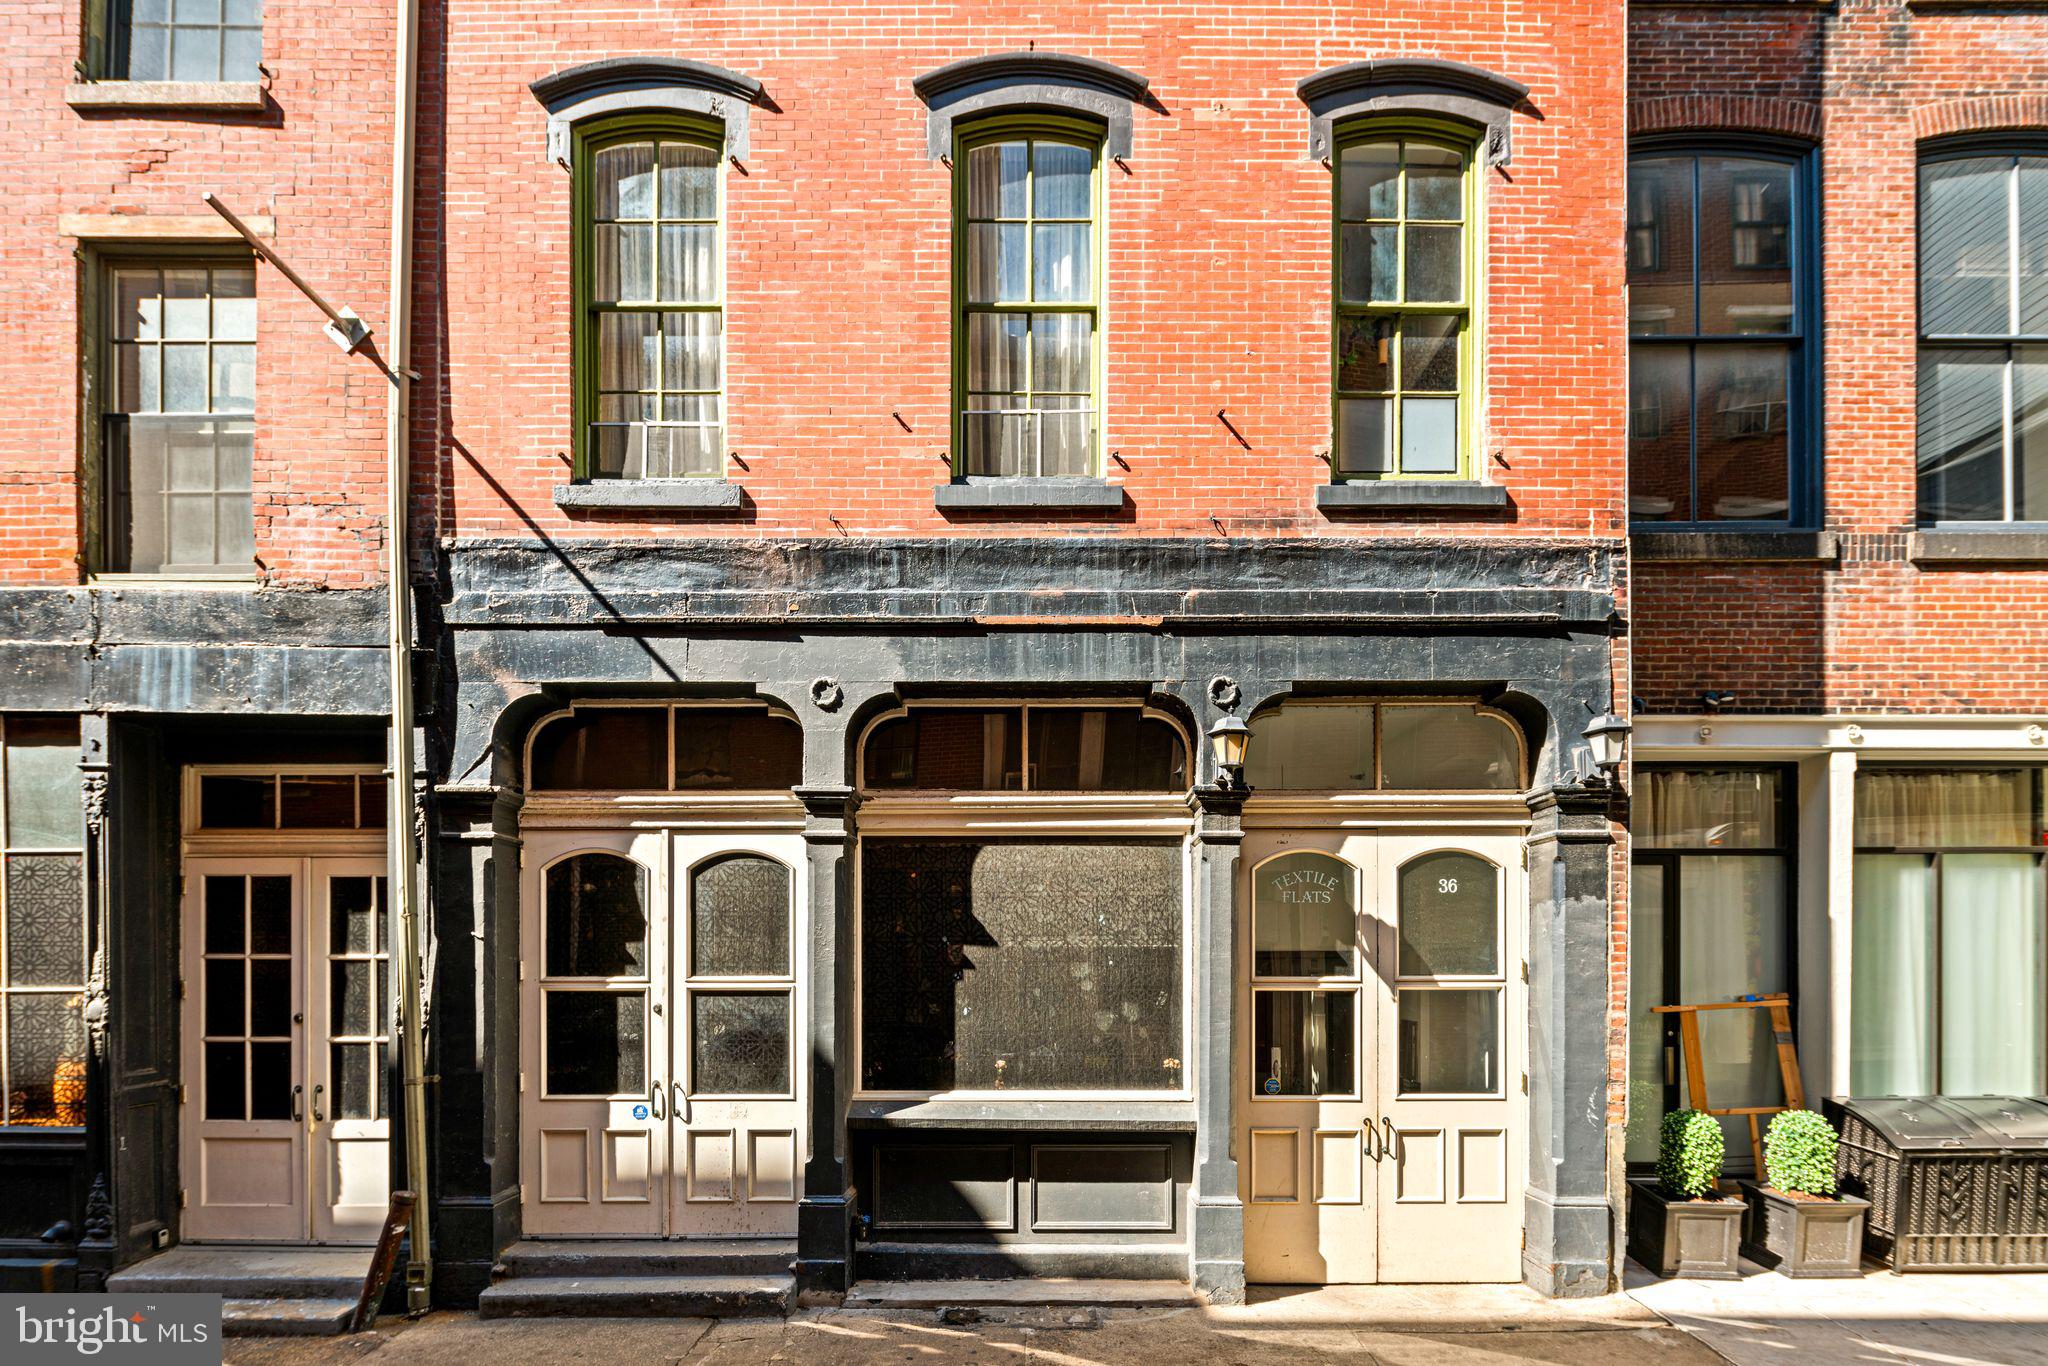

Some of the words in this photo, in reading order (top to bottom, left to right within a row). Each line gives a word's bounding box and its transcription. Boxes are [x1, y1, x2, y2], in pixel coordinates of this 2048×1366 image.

[1271, 870, 1340, 891] TEXTILE
[1438, 878, 1458, 893] 36
[1281, 890, 1331, 904] FLATS
